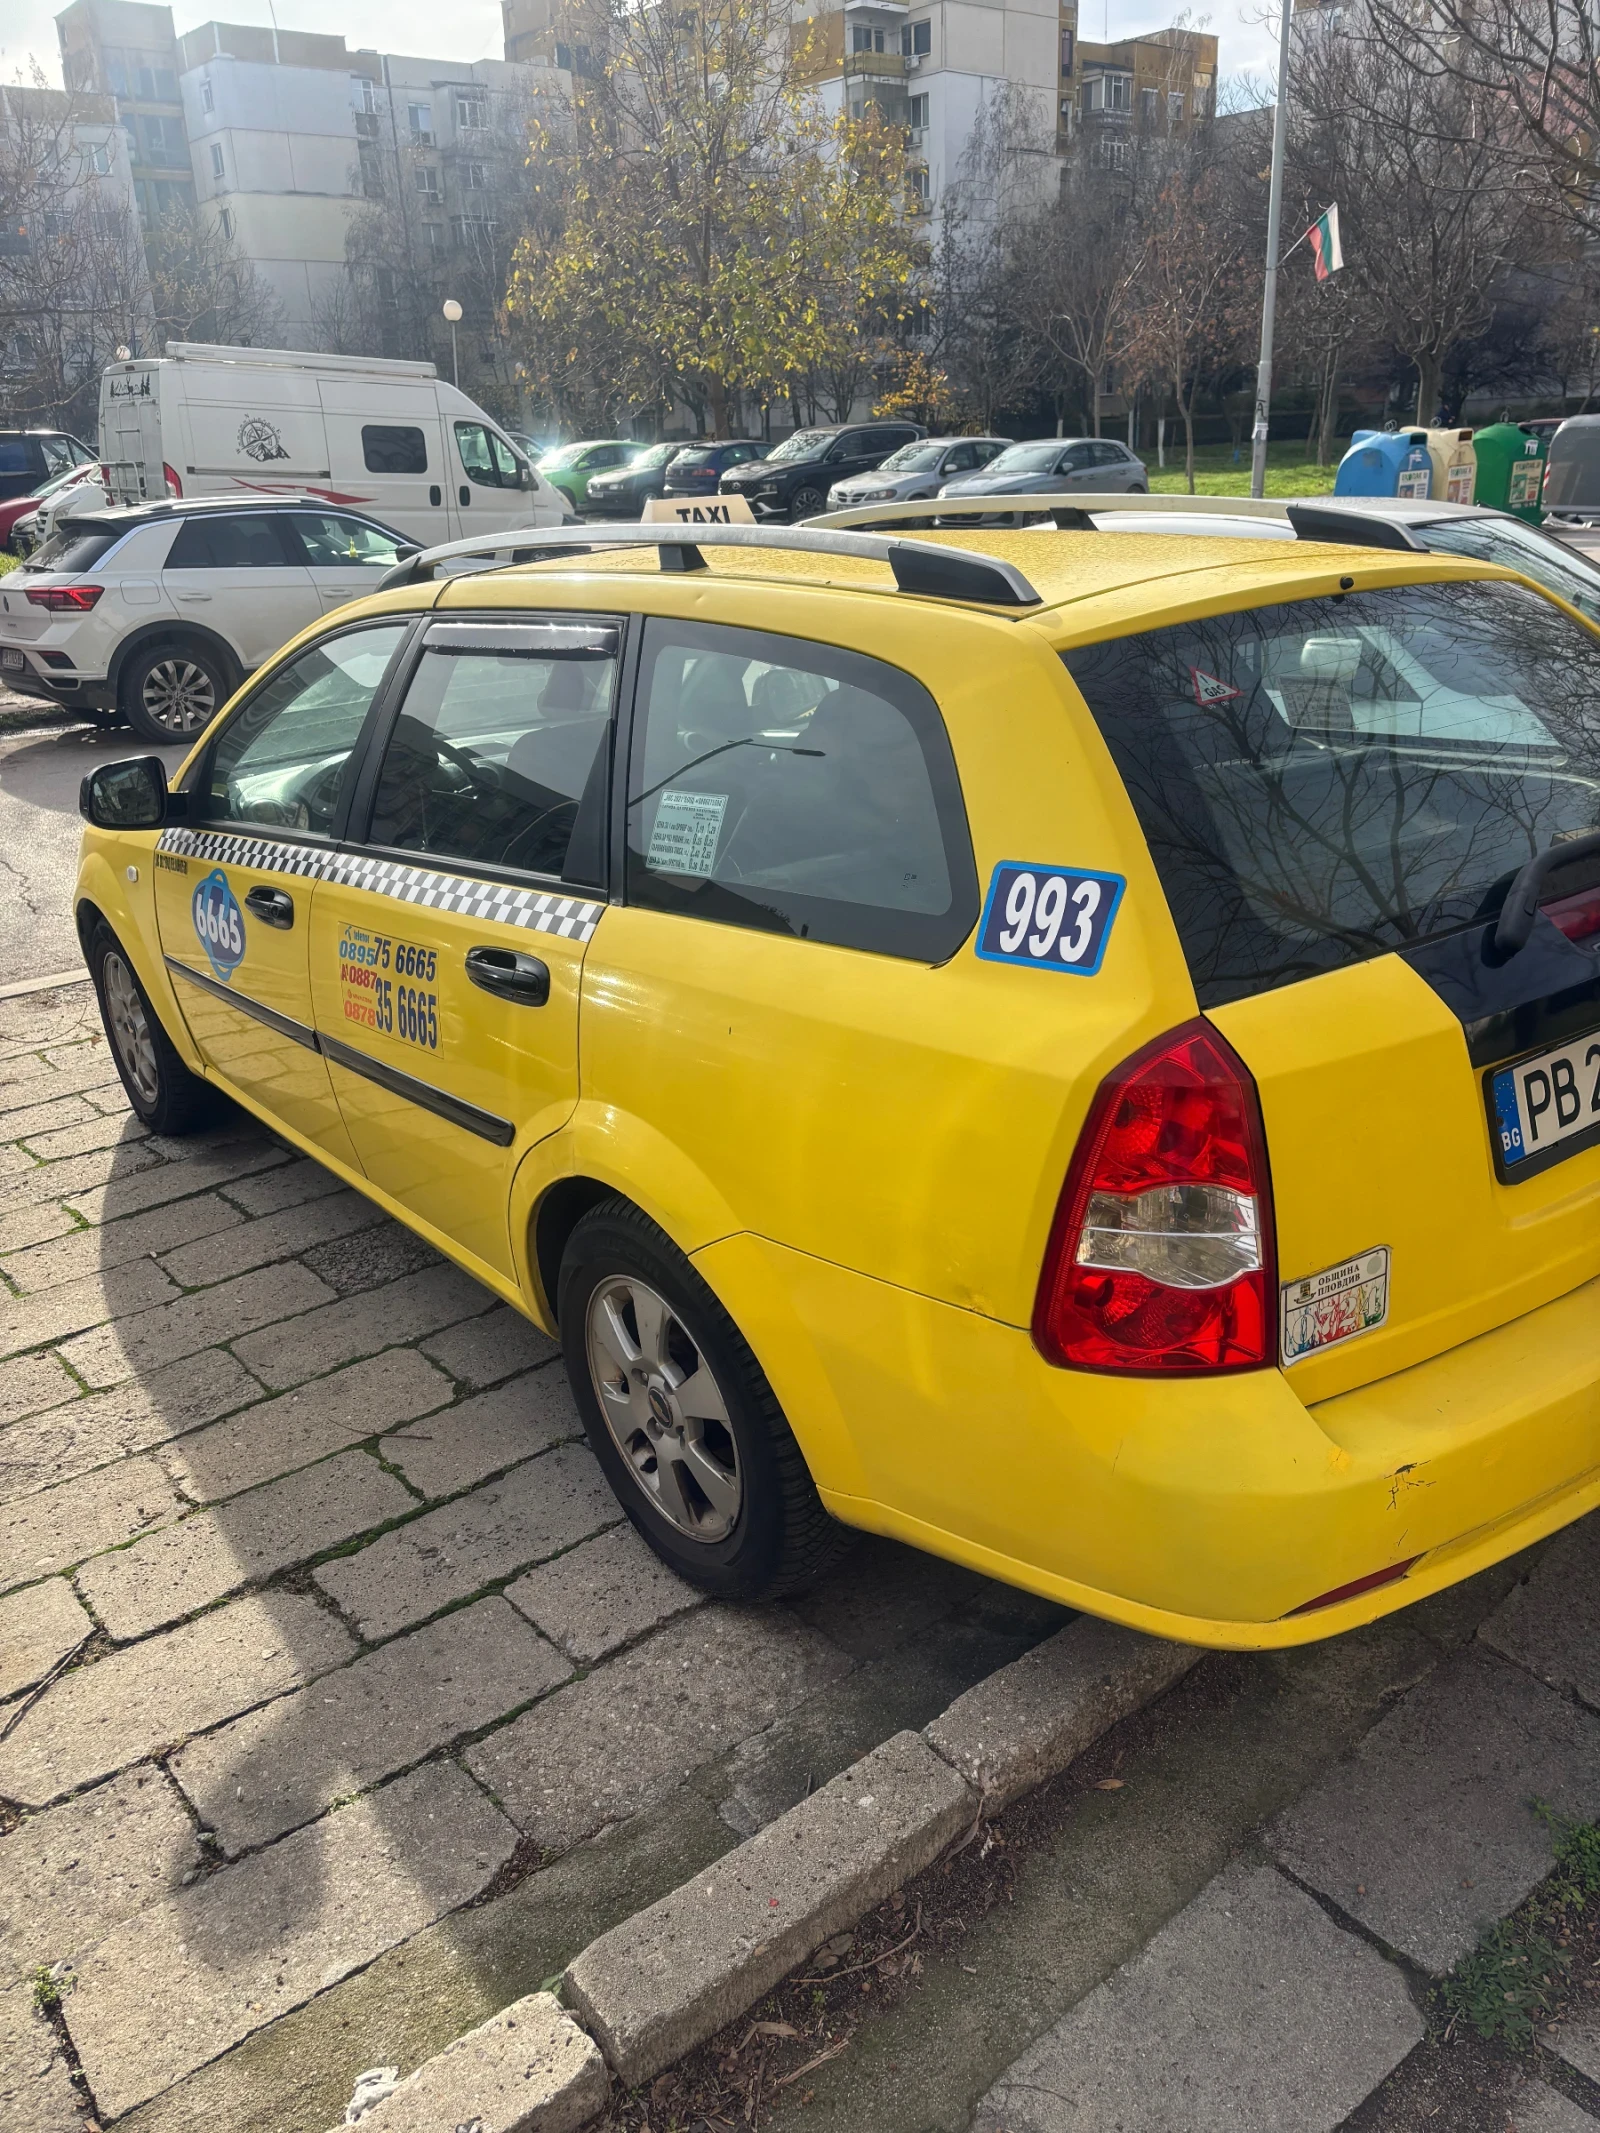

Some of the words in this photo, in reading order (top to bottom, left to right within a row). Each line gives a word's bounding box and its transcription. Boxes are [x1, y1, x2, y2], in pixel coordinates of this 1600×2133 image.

[675, 505, 731, 524] TAXI
[1204, 684, 1226, 697] GAS
[196, 893, 242, 954] 6665
[999, 872, 1101, 962] 993
[339, 939, 375, 966] 0895
[374, 936, 391, 969] 75
[395, 944, 437, 982] 6665
[349, 965, 377, 989] 0887
[344, 1000, 376, 1027] 0878
[375, 977, 392, 1033] 35
[397, 985, 437, 1049] 6665
[1523, 1058, 1581, 1142] PB
[1500, 1127, 1521, 1152] BG
[1317, 1273, 1361, 1296] ПЛОВДИВ
[1318, 1263, 1360, 1286] ОБЩИНА
[1292, 1286, 1380, 1345] 0724
